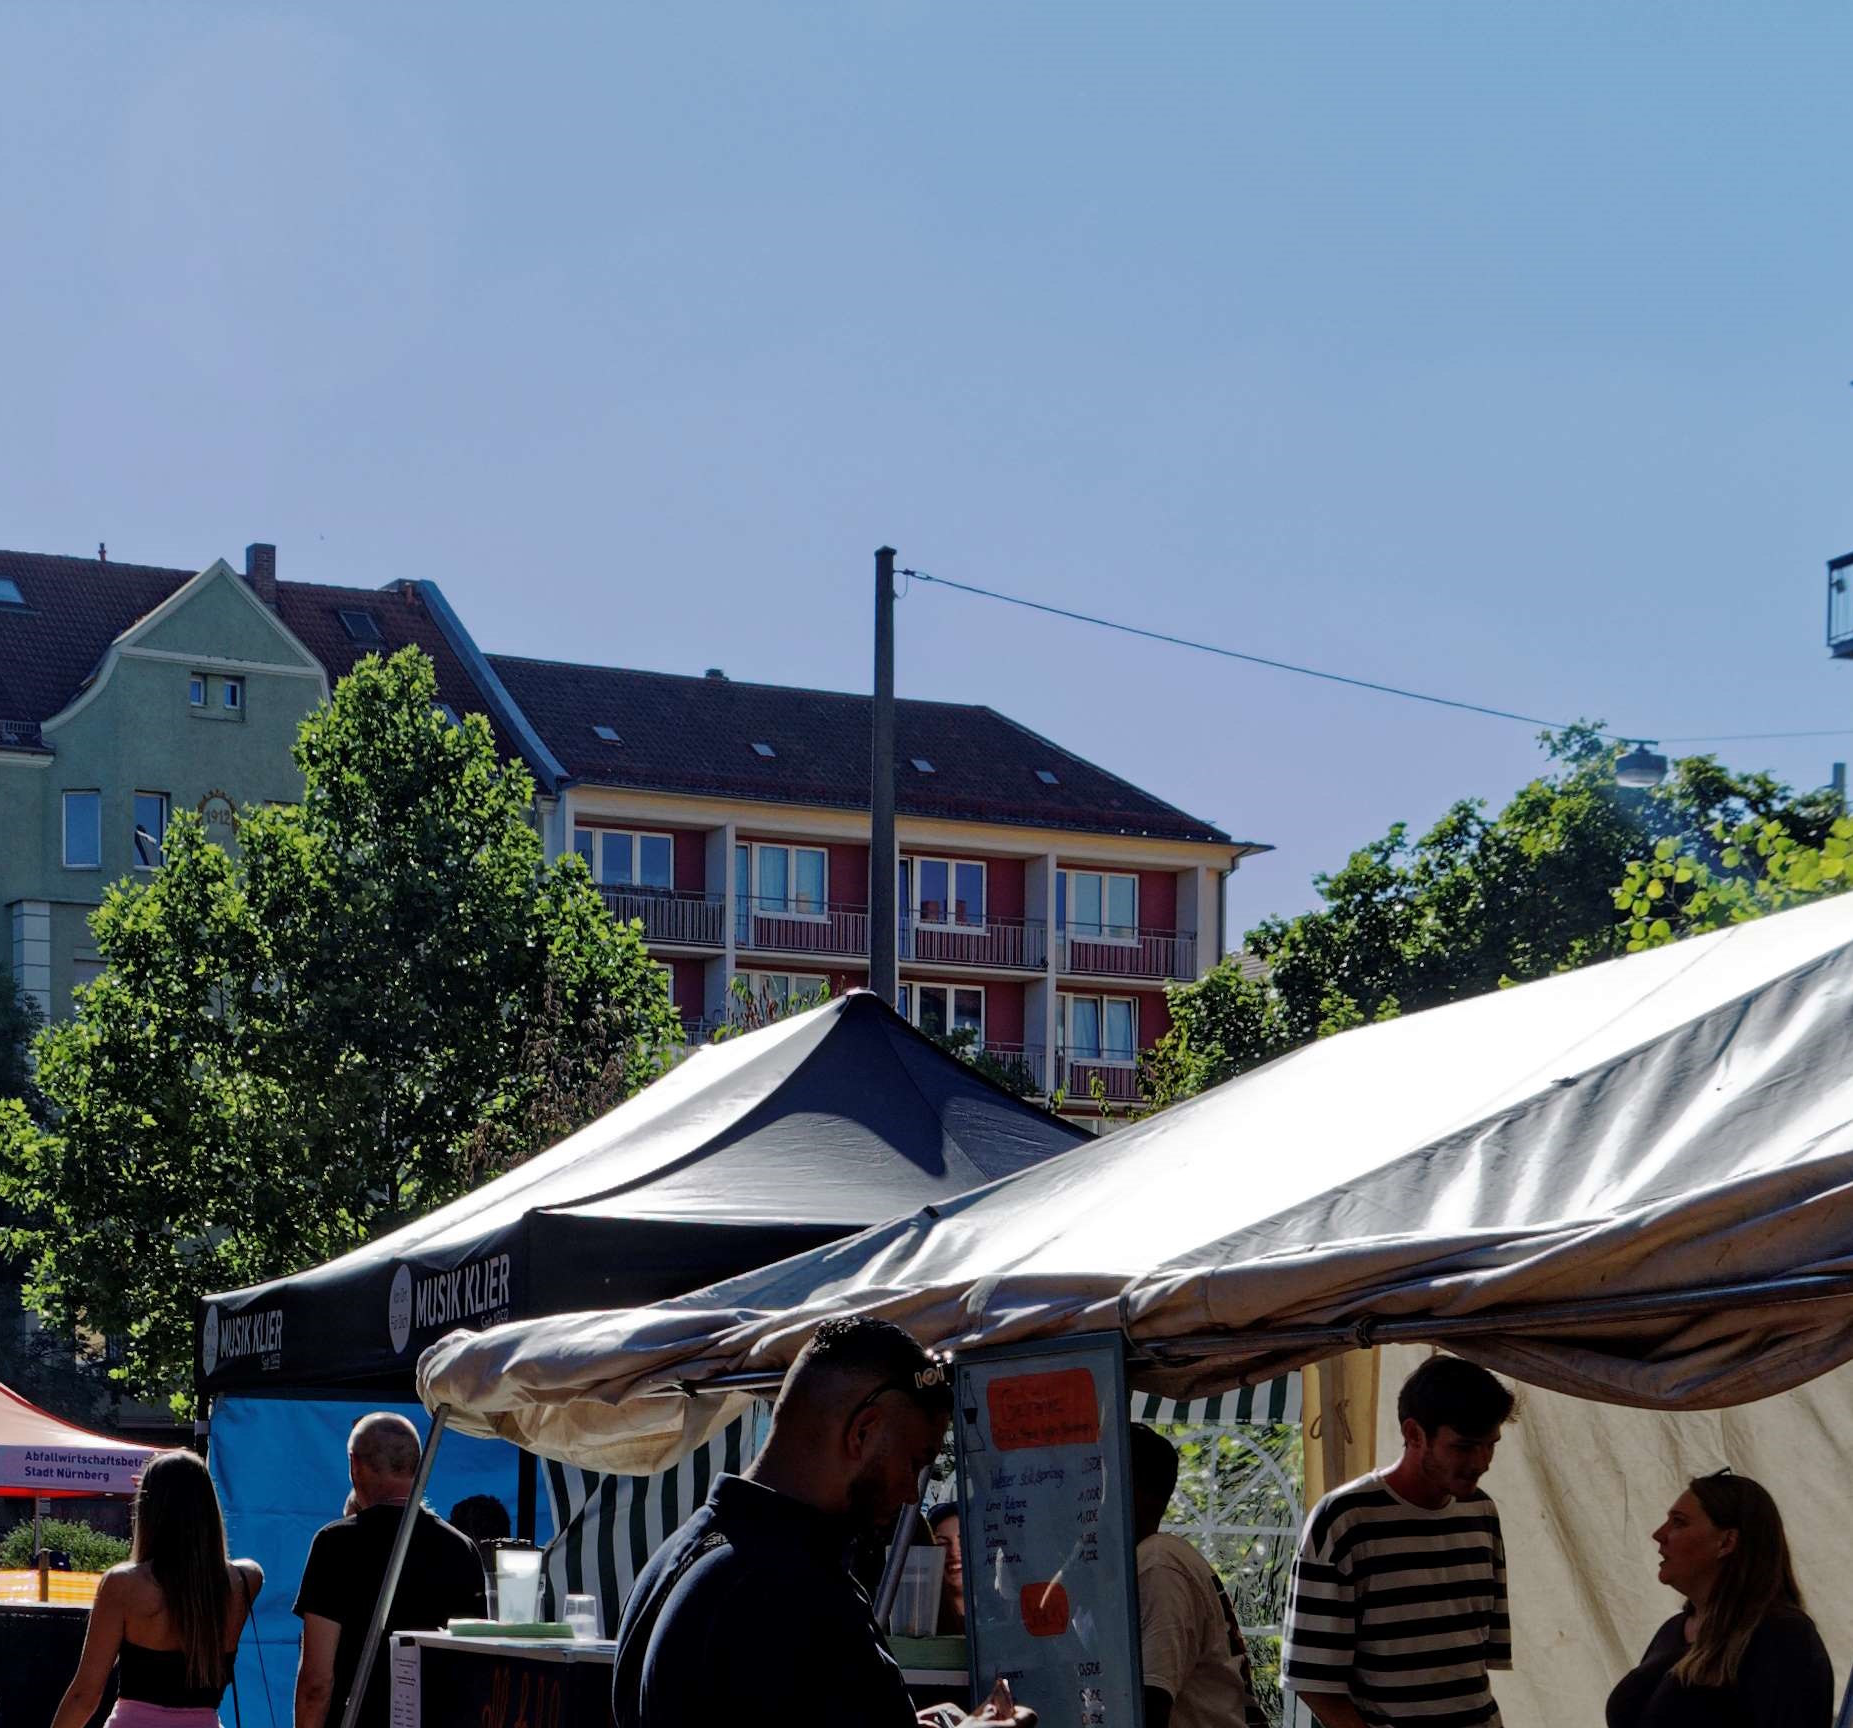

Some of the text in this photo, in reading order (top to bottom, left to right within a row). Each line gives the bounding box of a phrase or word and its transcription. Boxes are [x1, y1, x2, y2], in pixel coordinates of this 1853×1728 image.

[415, 1253, 511, 1329] MUSIK KLIER
[219, 1314, 252, 1359] MUSIK
[251, 1309, 283, 1354] KLIER
[24, 1450, 144, 1468] Abfallwirtschaftsbetr
[24, 1466, 111, 1483] Stadt Nürnberg
